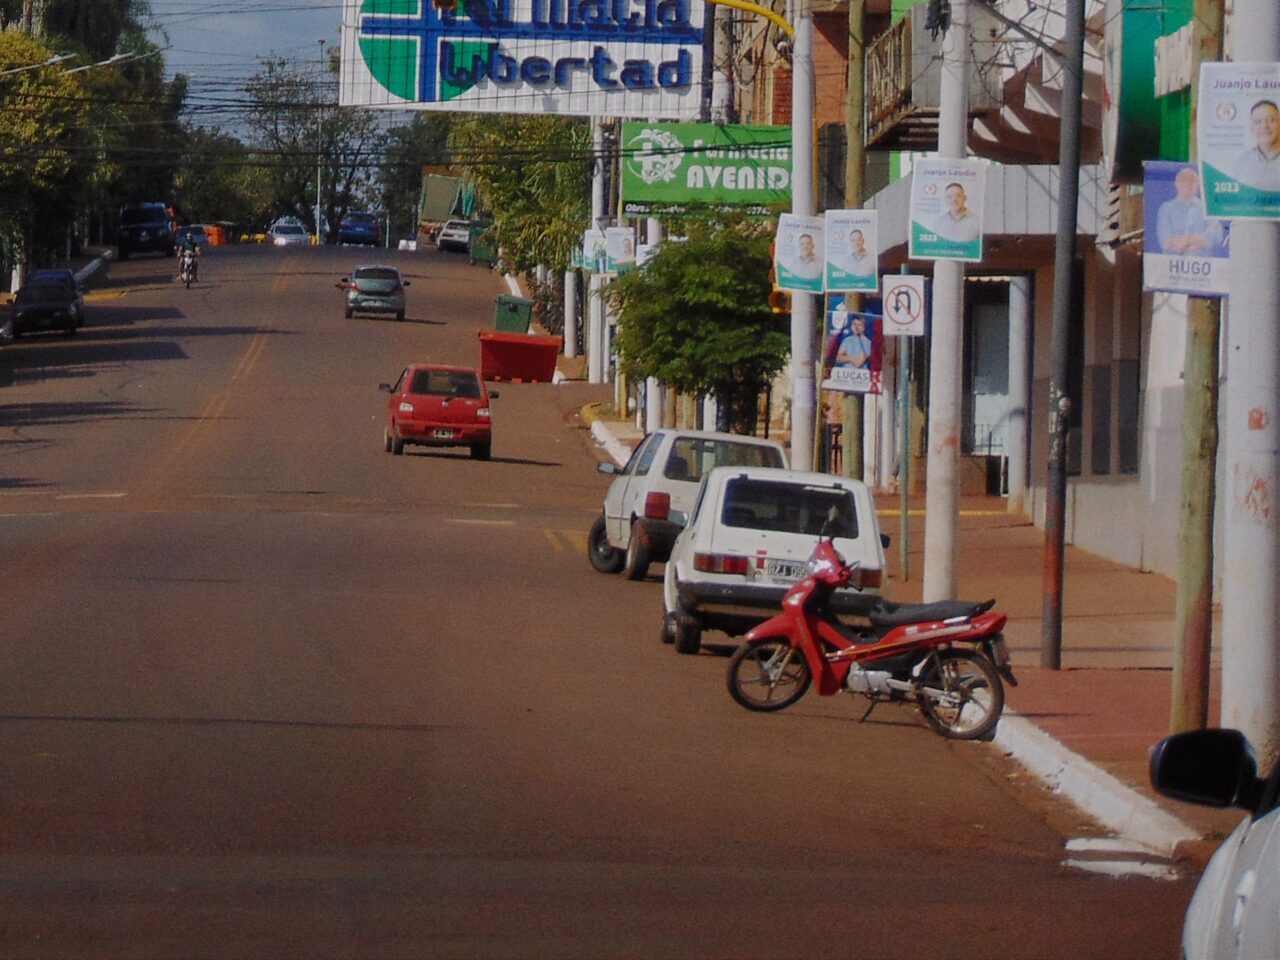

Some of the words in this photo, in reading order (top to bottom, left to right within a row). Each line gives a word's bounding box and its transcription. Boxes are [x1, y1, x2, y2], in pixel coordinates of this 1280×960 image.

[439, 40, 693, 92] Libertad
[1254, 79, 1280, 89] Lau
[686, 165, 793, 190] AVENID
[1169, 260, 1211, 276] HUGO
[836, 370, 869, 381] LUCAS
